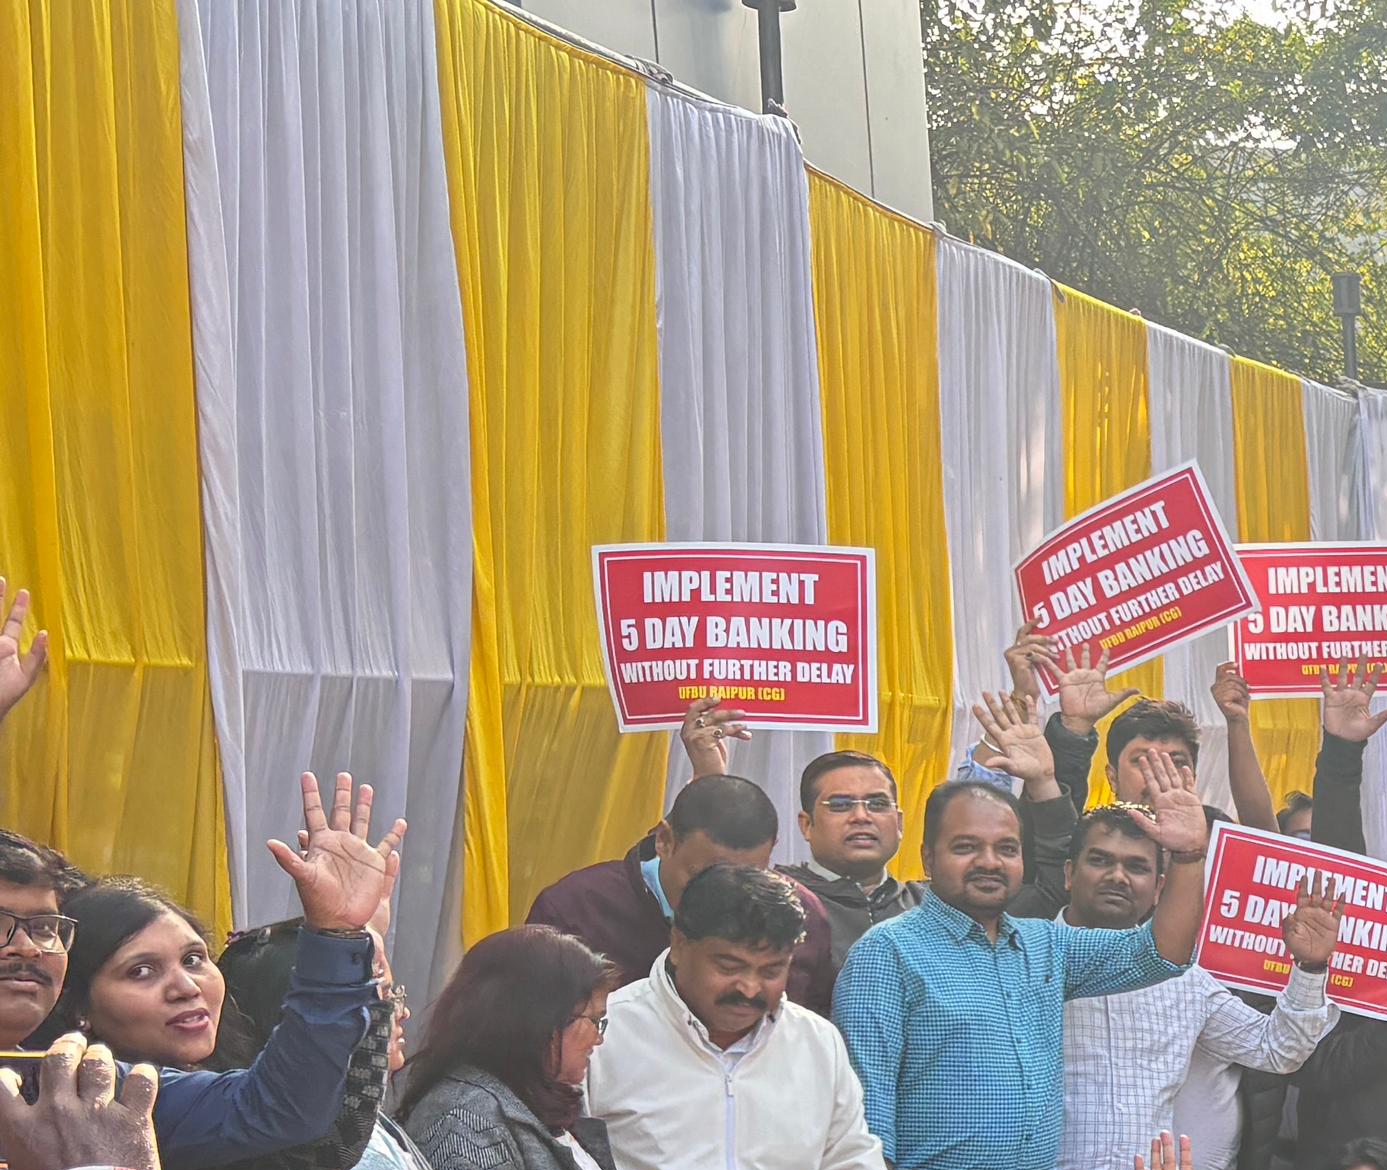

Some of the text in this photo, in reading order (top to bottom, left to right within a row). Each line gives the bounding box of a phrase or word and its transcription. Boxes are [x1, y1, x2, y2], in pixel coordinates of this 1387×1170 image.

[1042, 501, 1169, 584] IMPLEMENT
[643, 571, 819, 604] IMPLEMENT
[1033, 530, 1209, 628] 5 DAY BANKING
[1110, 561, 1224, 625] FURTHER DELAY
[621, 616, 847, 652] 5 DAY BANKING
[1270, 606, 1315, 633] DAY
[1244, 642, 1318, 660] WITHOUT
[621, 659, 854, 684] WITHOUT FURTHER DELAY
[708, 685, 756, 701] RAIPUR
[1221, 890, 1240, 917] 5
